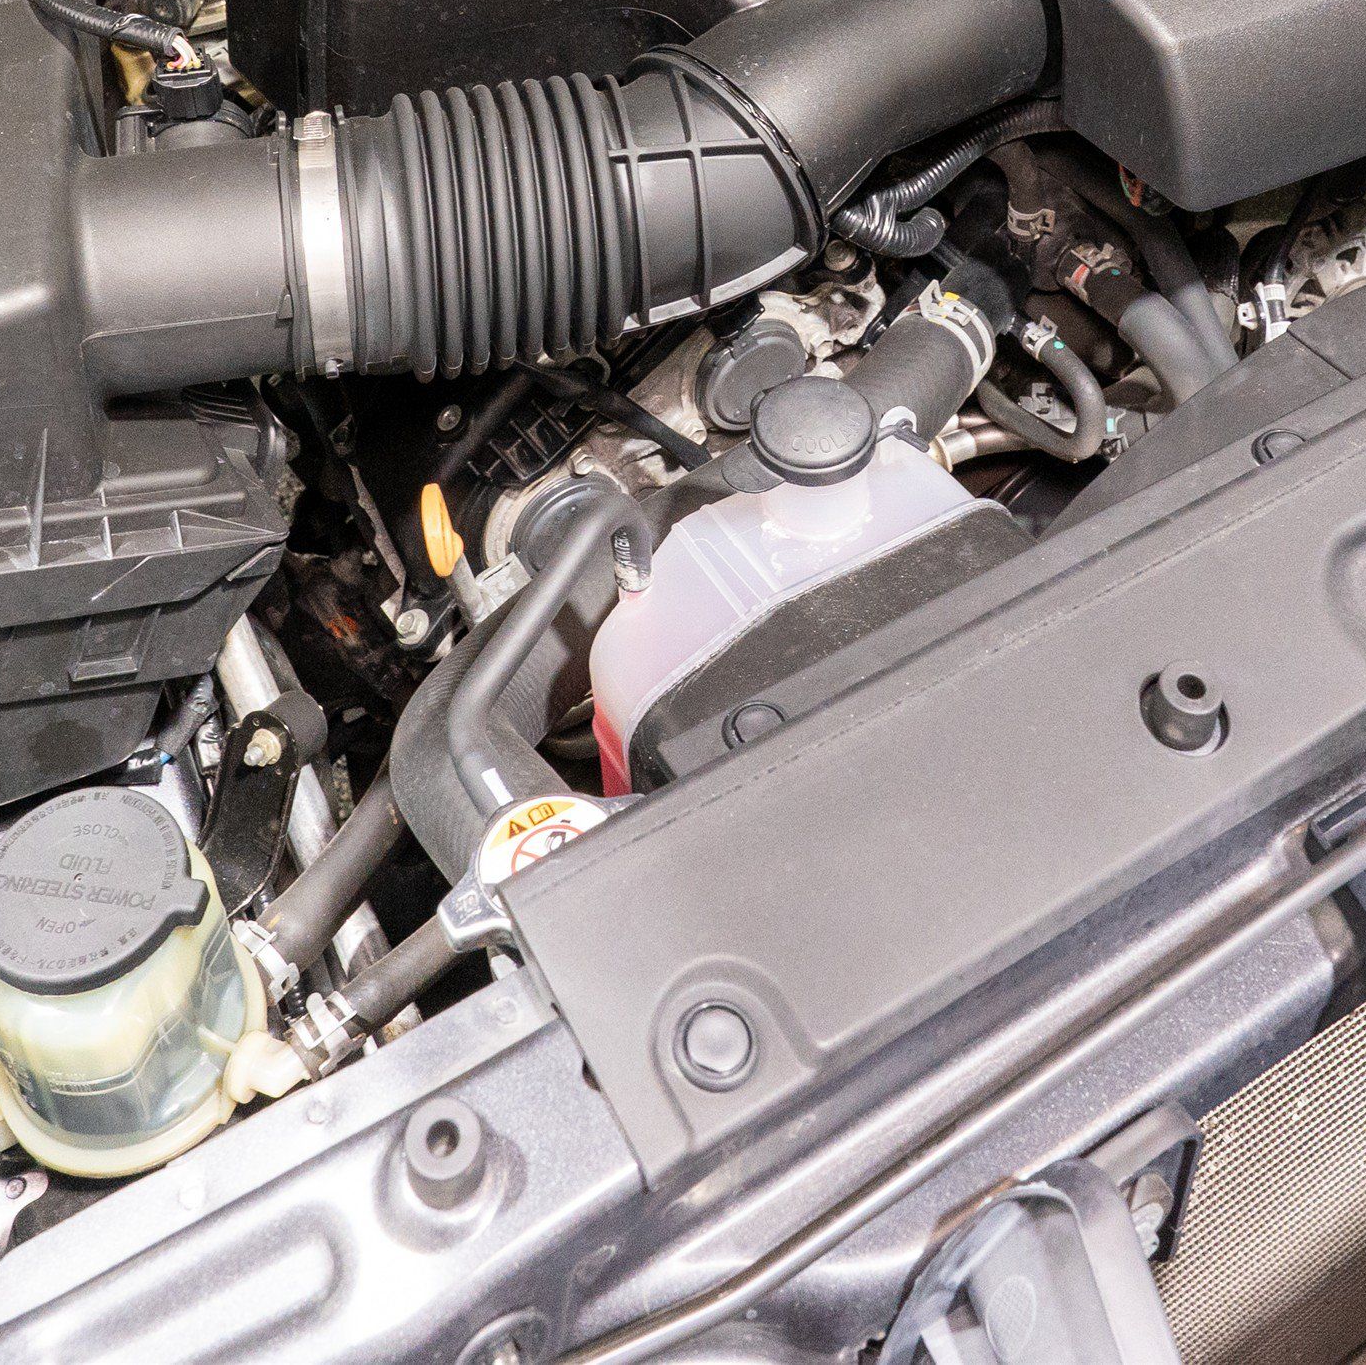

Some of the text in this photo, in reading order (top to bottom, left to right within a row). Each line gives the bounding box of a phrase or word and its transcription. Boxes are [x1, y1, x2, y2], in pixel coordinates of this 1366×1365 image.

[73, 823, 120, 841] CLOSE
[58, 852, 114, 875] FLUID
[88, 884, 157, 910] POWER
[34, 916, 76, 935] OPEN
